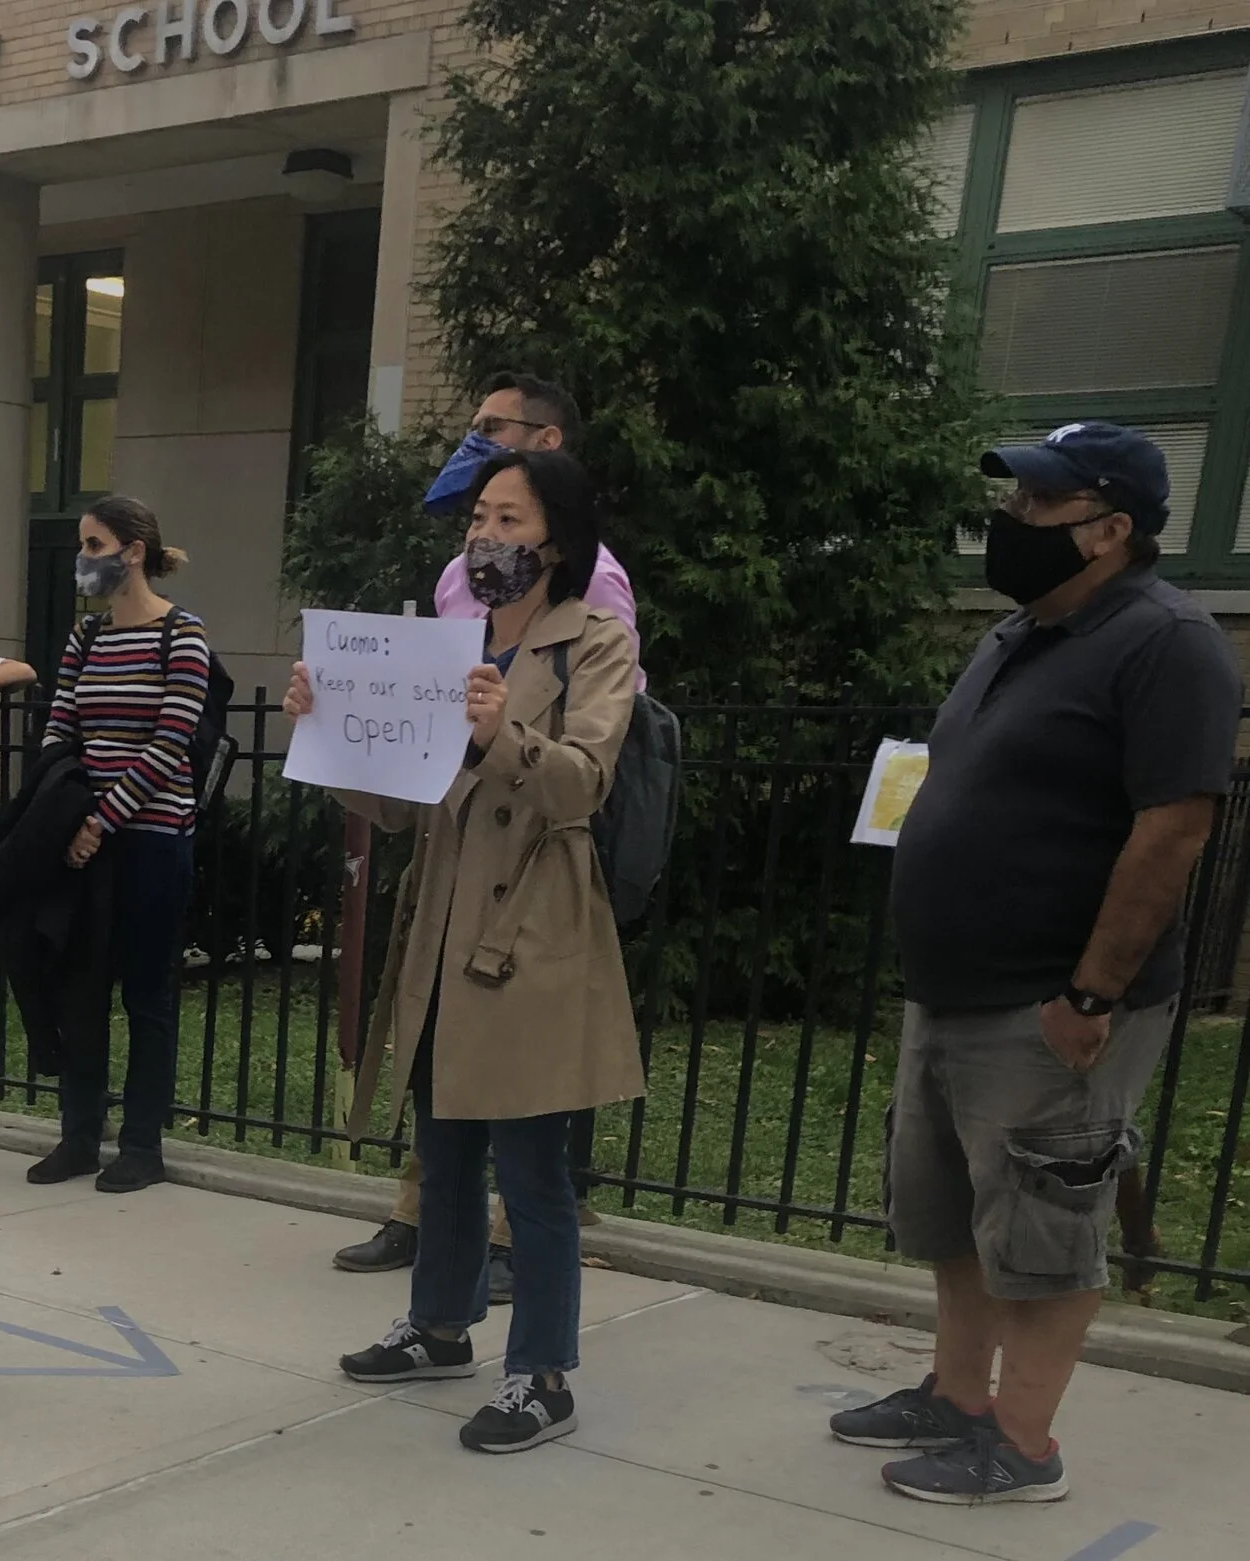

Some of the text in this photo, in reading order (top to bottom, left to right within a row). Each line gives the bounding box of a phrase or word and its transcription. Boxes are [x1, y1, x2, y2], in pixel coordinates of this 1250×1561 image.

[67, 0, 355, 80] SCHOOL
[326, 621, 390, 656] Cuomo:
[315, 666, 356, 699] Keep
[369, 680, 398, 697] our
